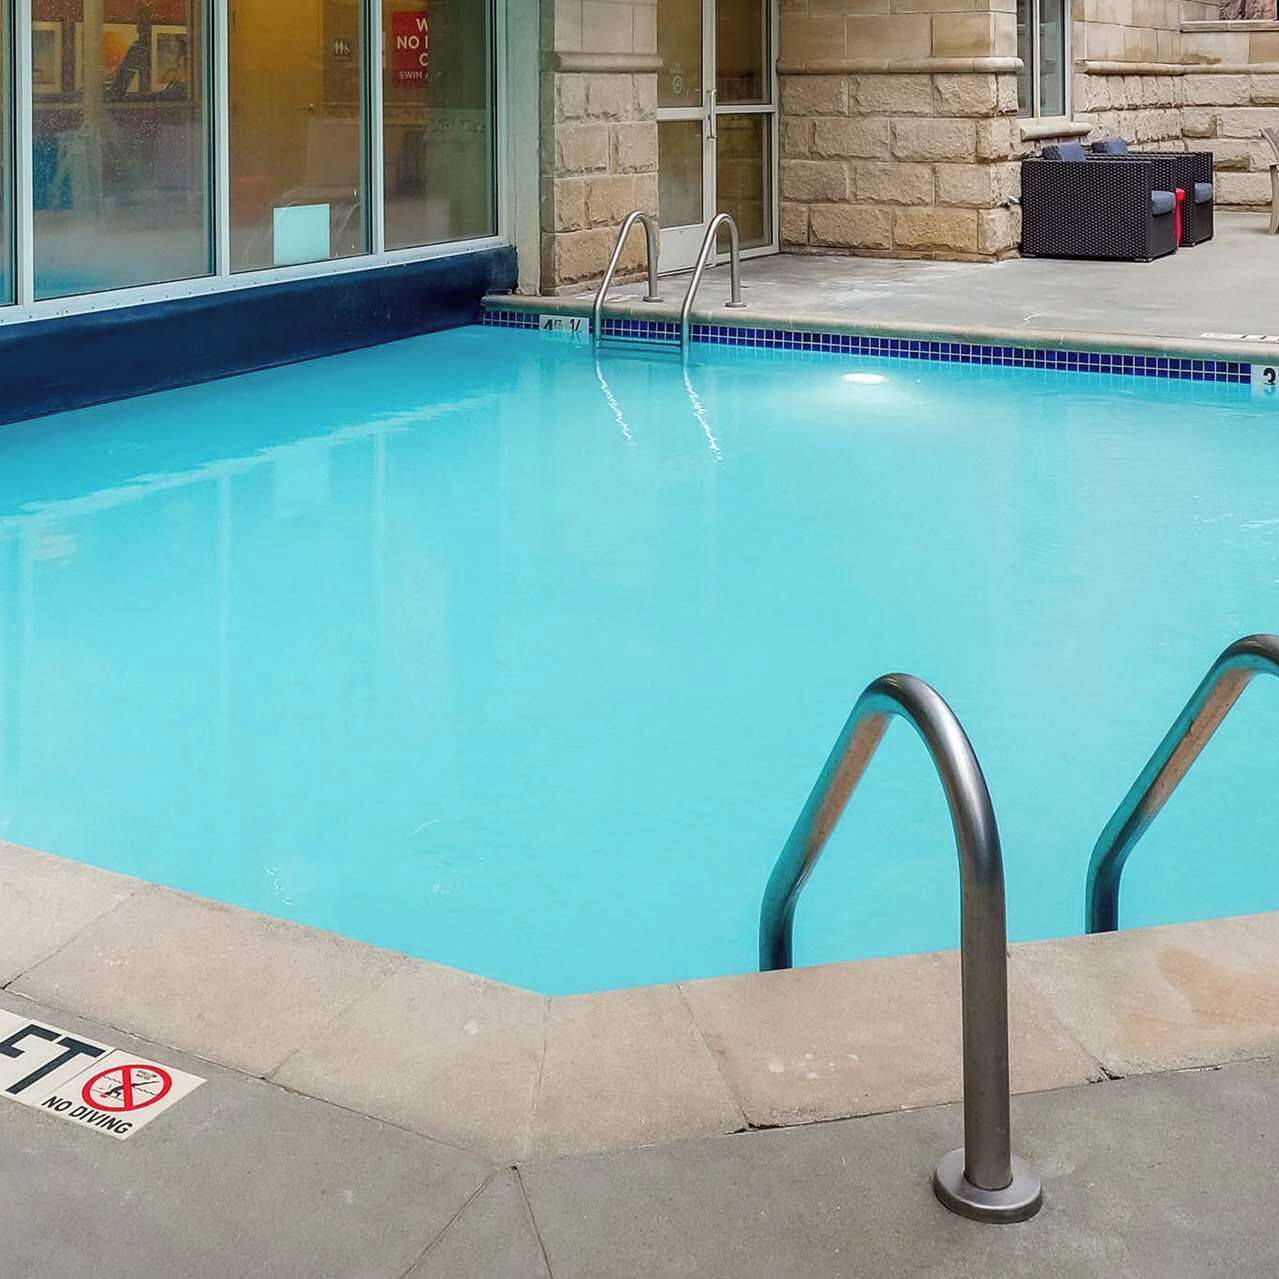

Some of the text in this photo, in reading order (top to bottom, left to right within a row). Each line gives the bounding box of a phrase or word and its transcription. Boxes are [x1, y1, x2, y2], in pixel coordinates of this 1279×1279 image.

[397, 35, 420, 49] NO
[400, 71, 423, 80] SWIM
[41, 1095, 133, 1135] NO DIVING
